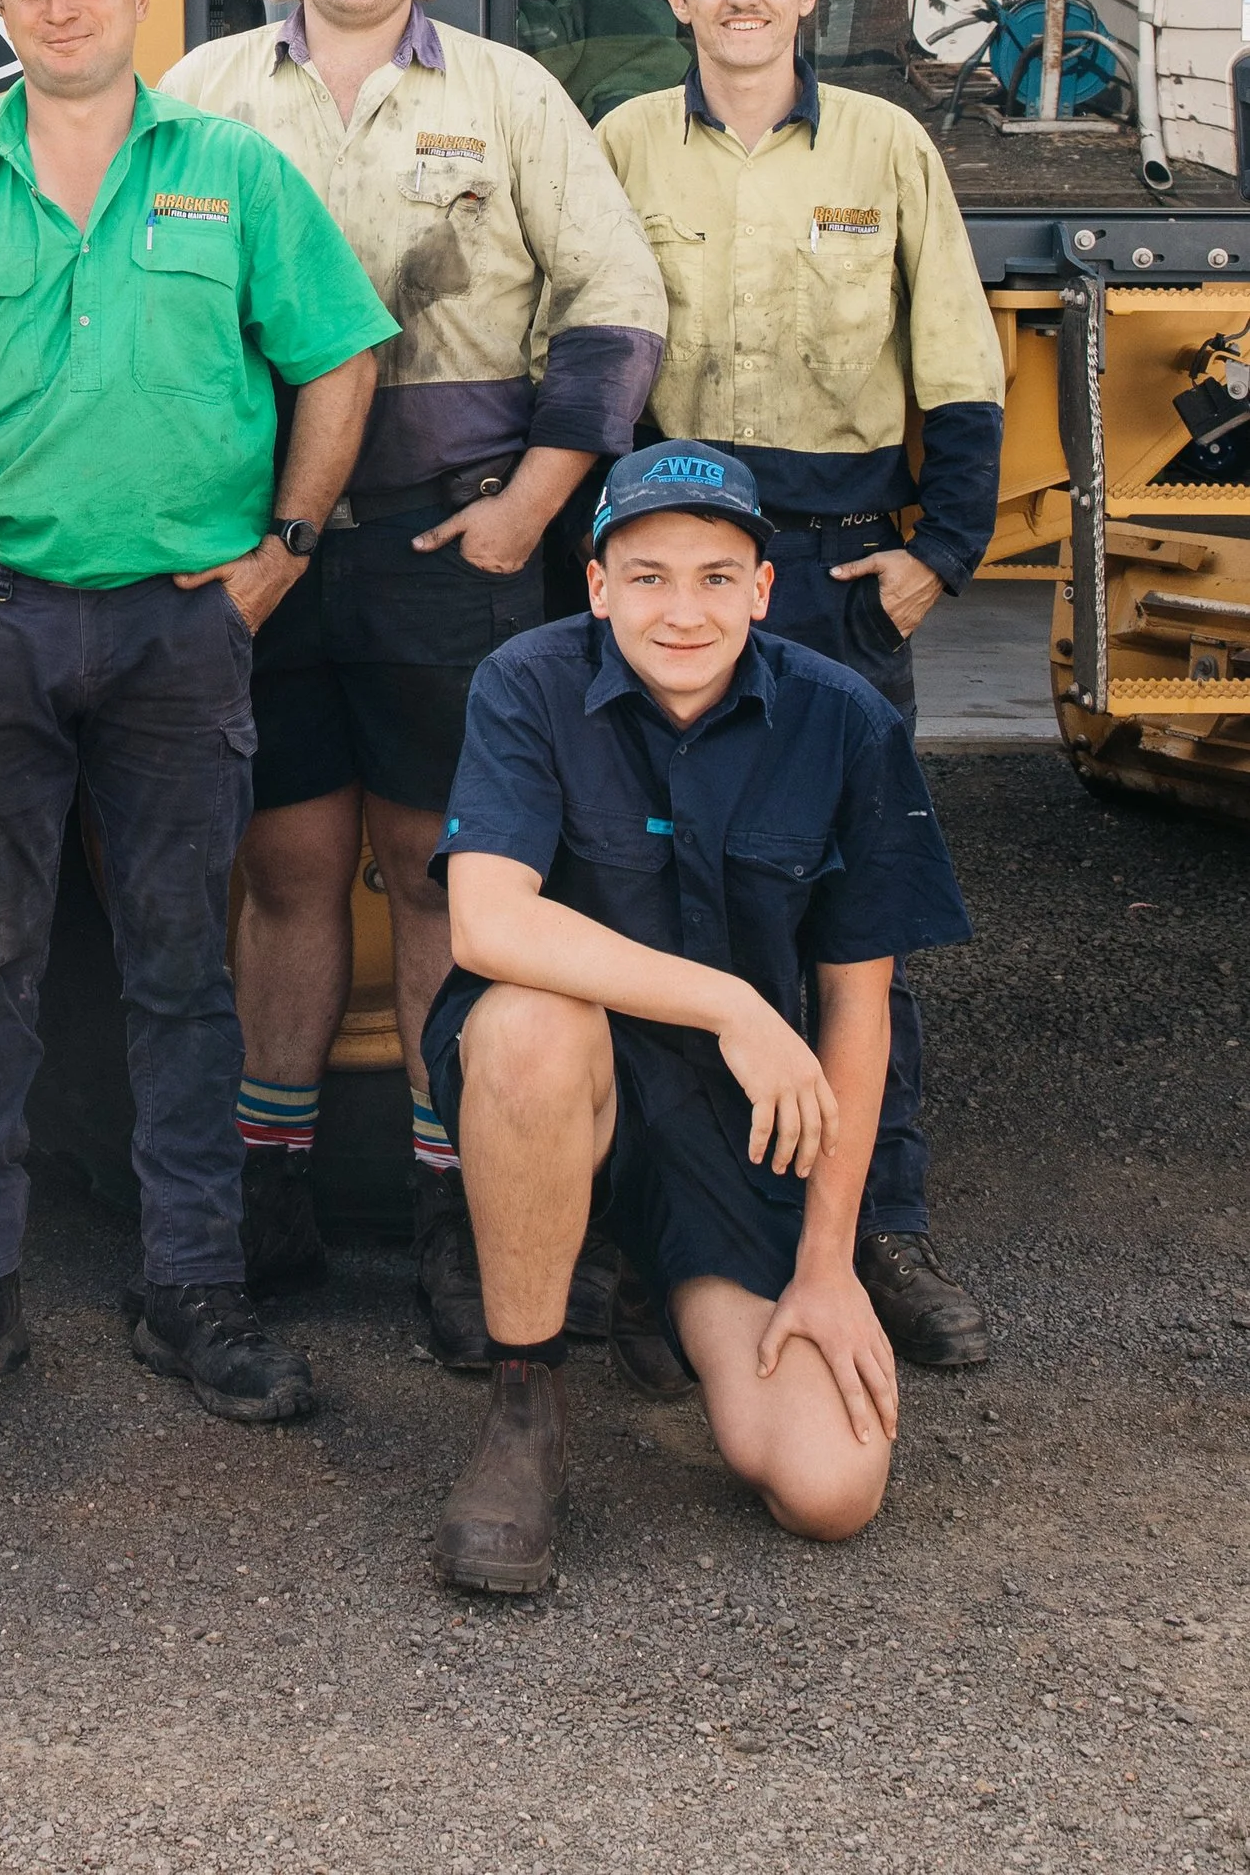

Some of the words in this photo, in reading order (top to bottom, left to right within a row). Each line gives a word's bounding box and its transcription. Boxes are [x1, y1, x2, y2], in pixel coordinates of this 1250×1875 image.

[416, 132, 486, 154] BRACKENS
[154, 193, 229, 214] BRACKENS
[171, 209, 187, 218] FIELD
[187, 212, 228, 223] MAINTENANCE
[814, 206, 881, 225] BRACKENS
[667, 457, 724, 481] WTG
